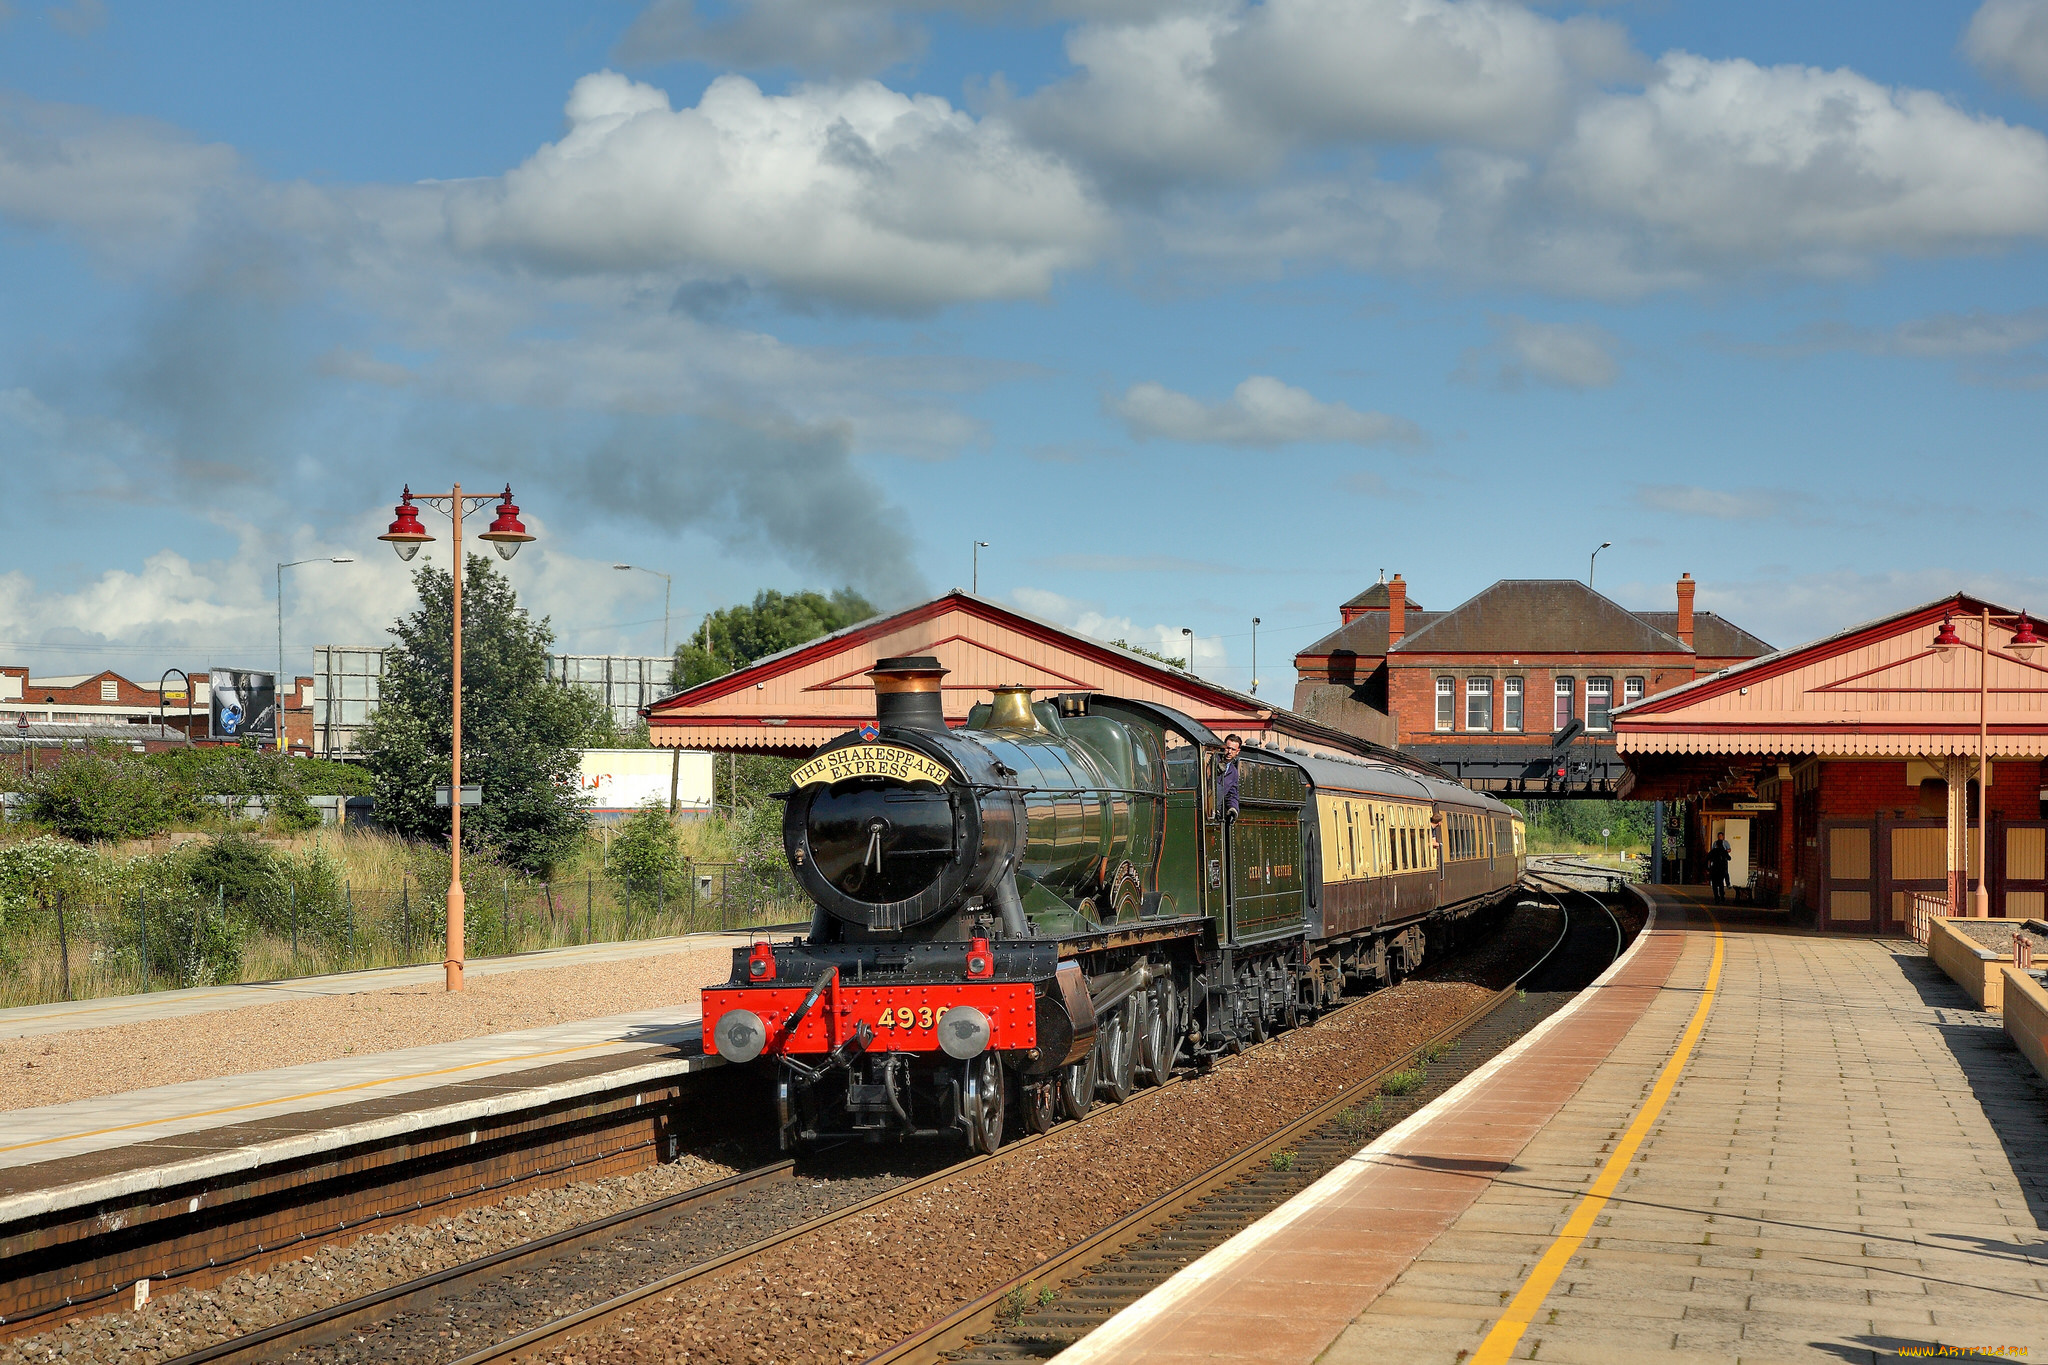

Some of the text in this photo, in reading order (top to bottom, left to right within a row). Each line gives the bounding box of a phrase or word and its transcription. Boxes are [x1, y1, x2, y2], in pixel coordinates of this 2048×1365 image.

[794, 747, 946, 784] THE SHAKESPEARE
[831, 760, 909, 780] EXPRESS
[1671, 818, 1678, 827] 3
